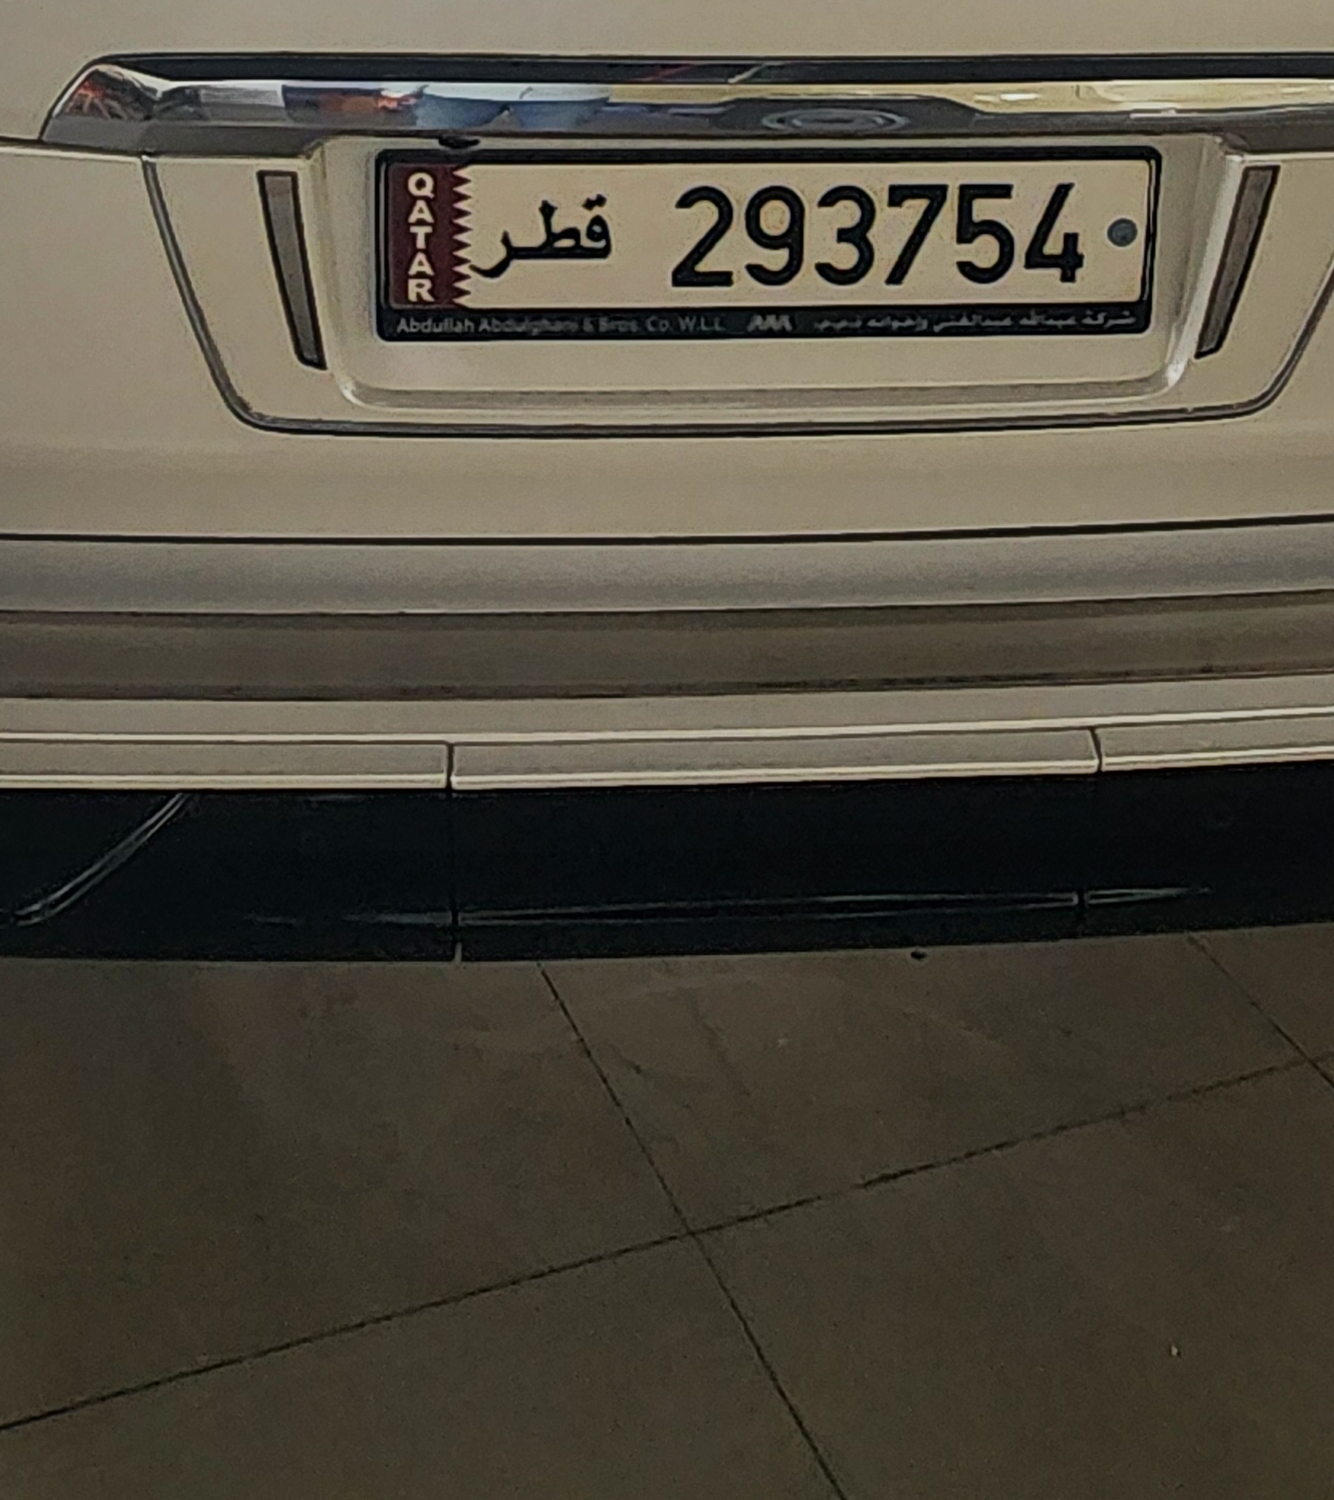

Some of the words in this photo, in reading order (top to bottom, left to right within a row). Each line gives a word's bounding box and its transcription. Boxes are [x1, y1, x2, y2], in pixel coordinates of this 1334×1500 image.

[407, 172, 435, 302] QATAR
[469, 193, 612, 279] قطر
[671, 183, 1084, 288] 293754
[396, 316, 475, 334] Abdullah
